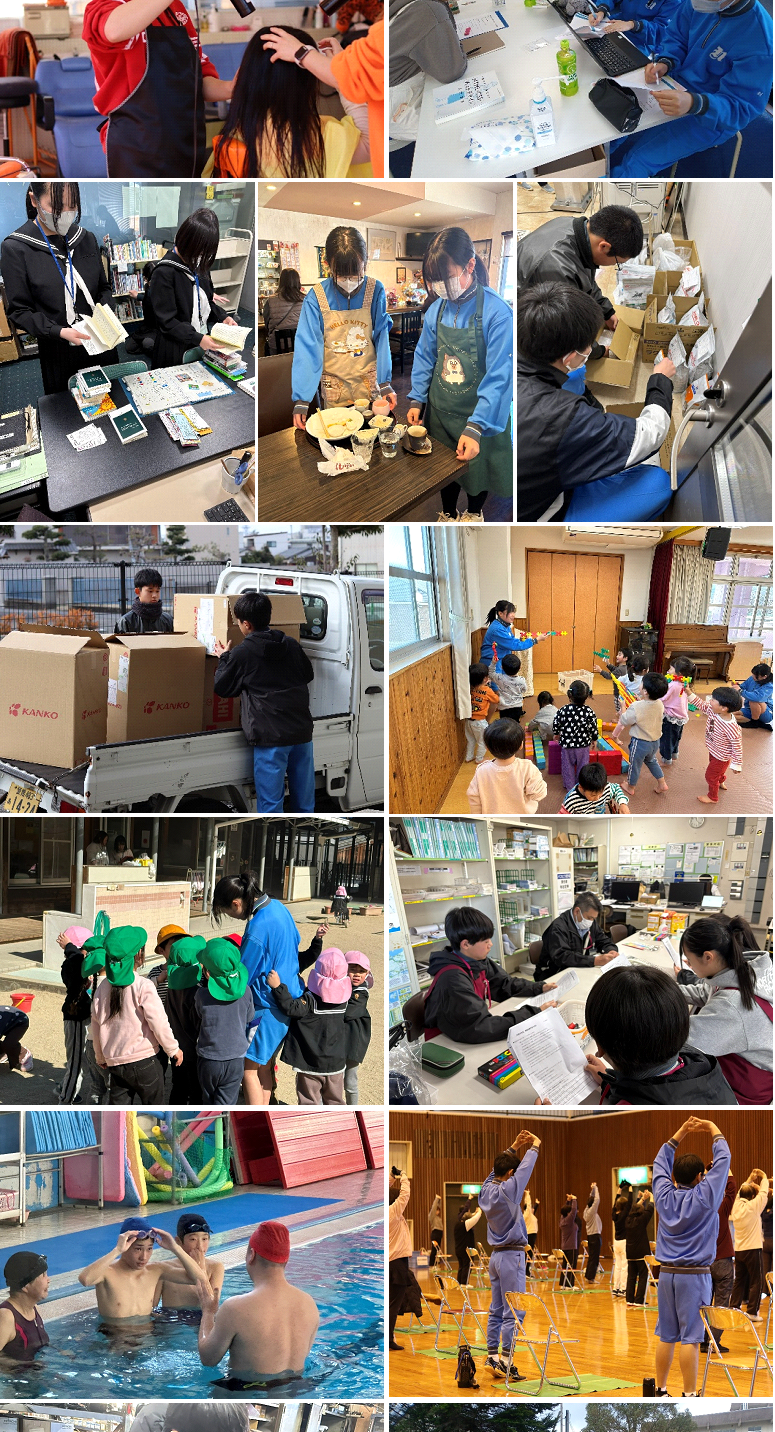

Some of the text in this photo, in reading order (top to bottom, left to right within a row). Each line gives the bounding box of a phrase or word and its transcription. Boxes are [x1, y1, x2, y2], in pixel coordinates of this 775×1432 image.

[330, 319, 368, 329] HELLO KITTY
[156, 701, 190, 711] KANKO
[22, 708, 58, 719] KANKO
